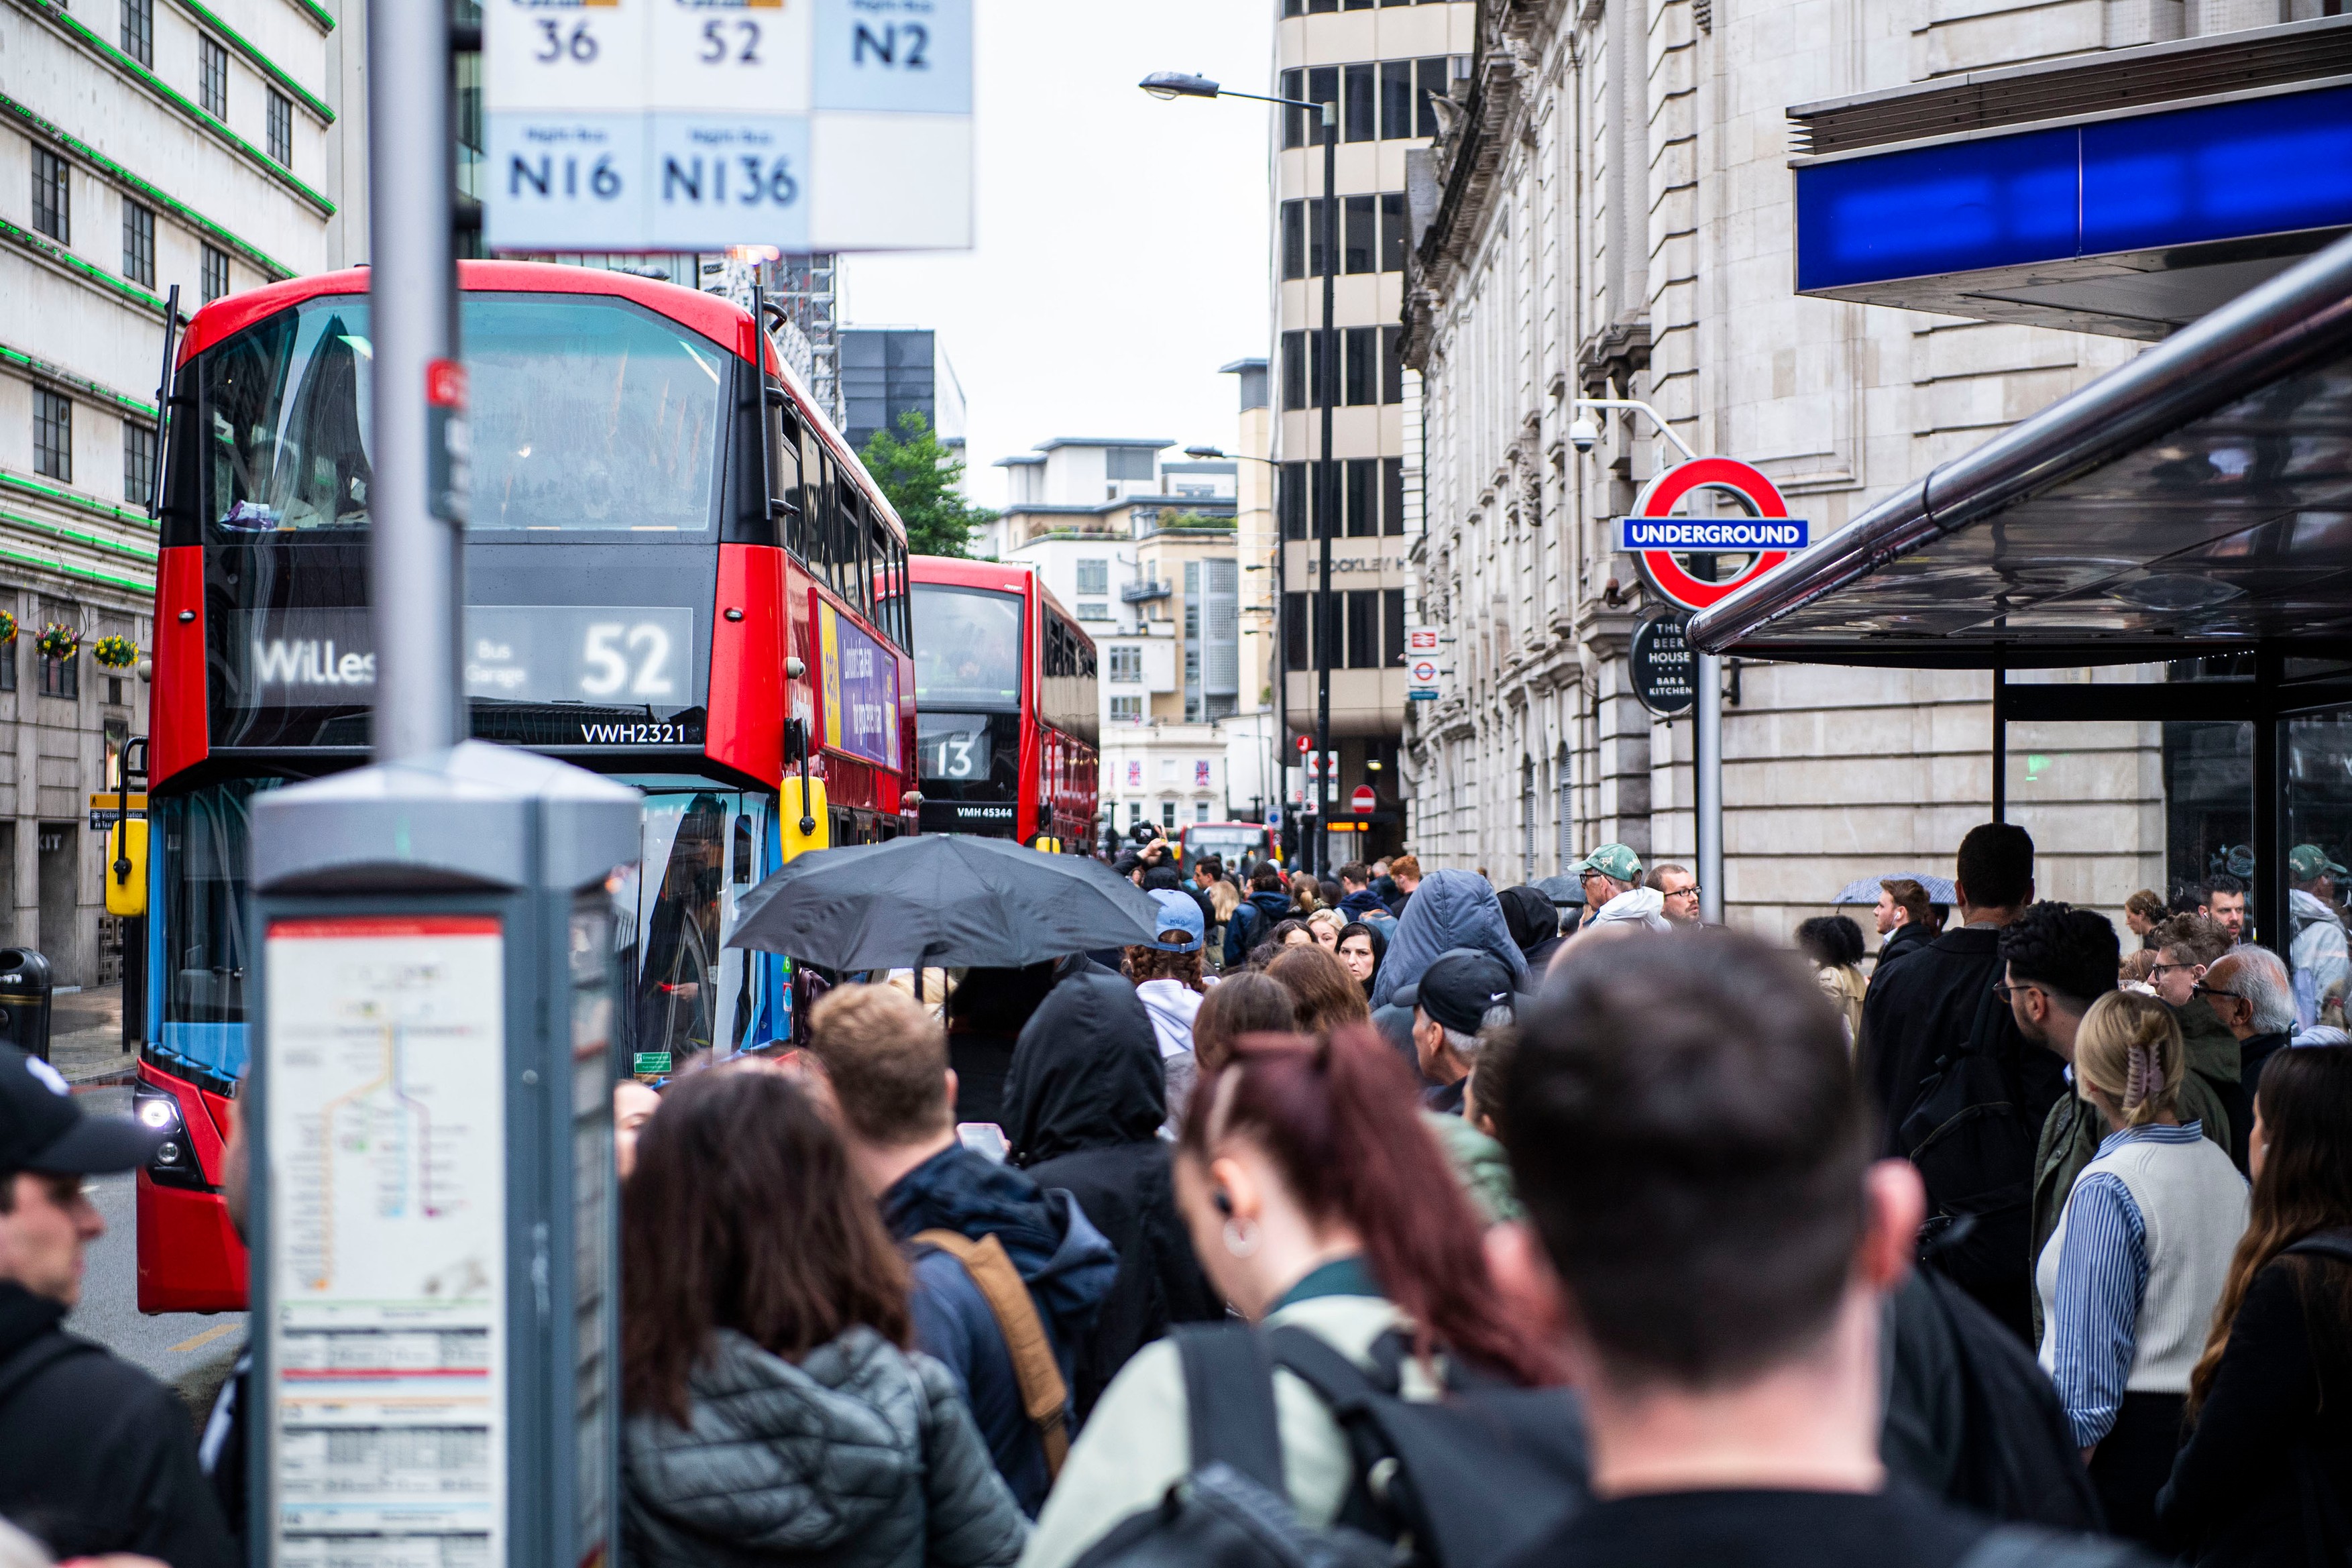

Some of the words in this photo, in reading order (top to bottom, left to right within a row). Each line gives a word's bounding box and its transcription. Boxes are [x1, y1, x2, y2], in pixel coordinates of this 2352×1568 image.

[537, 19, 599, 64] 36
[700, 19, 763, 65] 52
[852, 21, 931, 66] N2
[508, 155, 622, 199] N16
[663, 156, 798, 205] N136
[1632, 524, 1800, 544] UNDERGROUND
[1308, 556, 1391, 575] SOCKLEY
[1656, 623, 1681, 634] THE
[478, 639, 510, 659] Bus
[1653, 638, 1685, 649] BEER
[252, 638, 376, 683] Willes
[582, 622, 673, 694] 52
[1648, 652, 1691, 664] HOUSE
[465, 664, 525, 687] Garage
[1657, 677, 1676, 685] BAR
[1678, 677, 1685, 685] &
[1648, 687, 1693, 695] KITCHEN
[581, 724, 685, 742] VWH2321
[938, 741, 972, 777] 13
[957, 807, 981, 818] VMH
[983, 808, 1013, 818] 45344
[785, 956, 791, 970] 6
